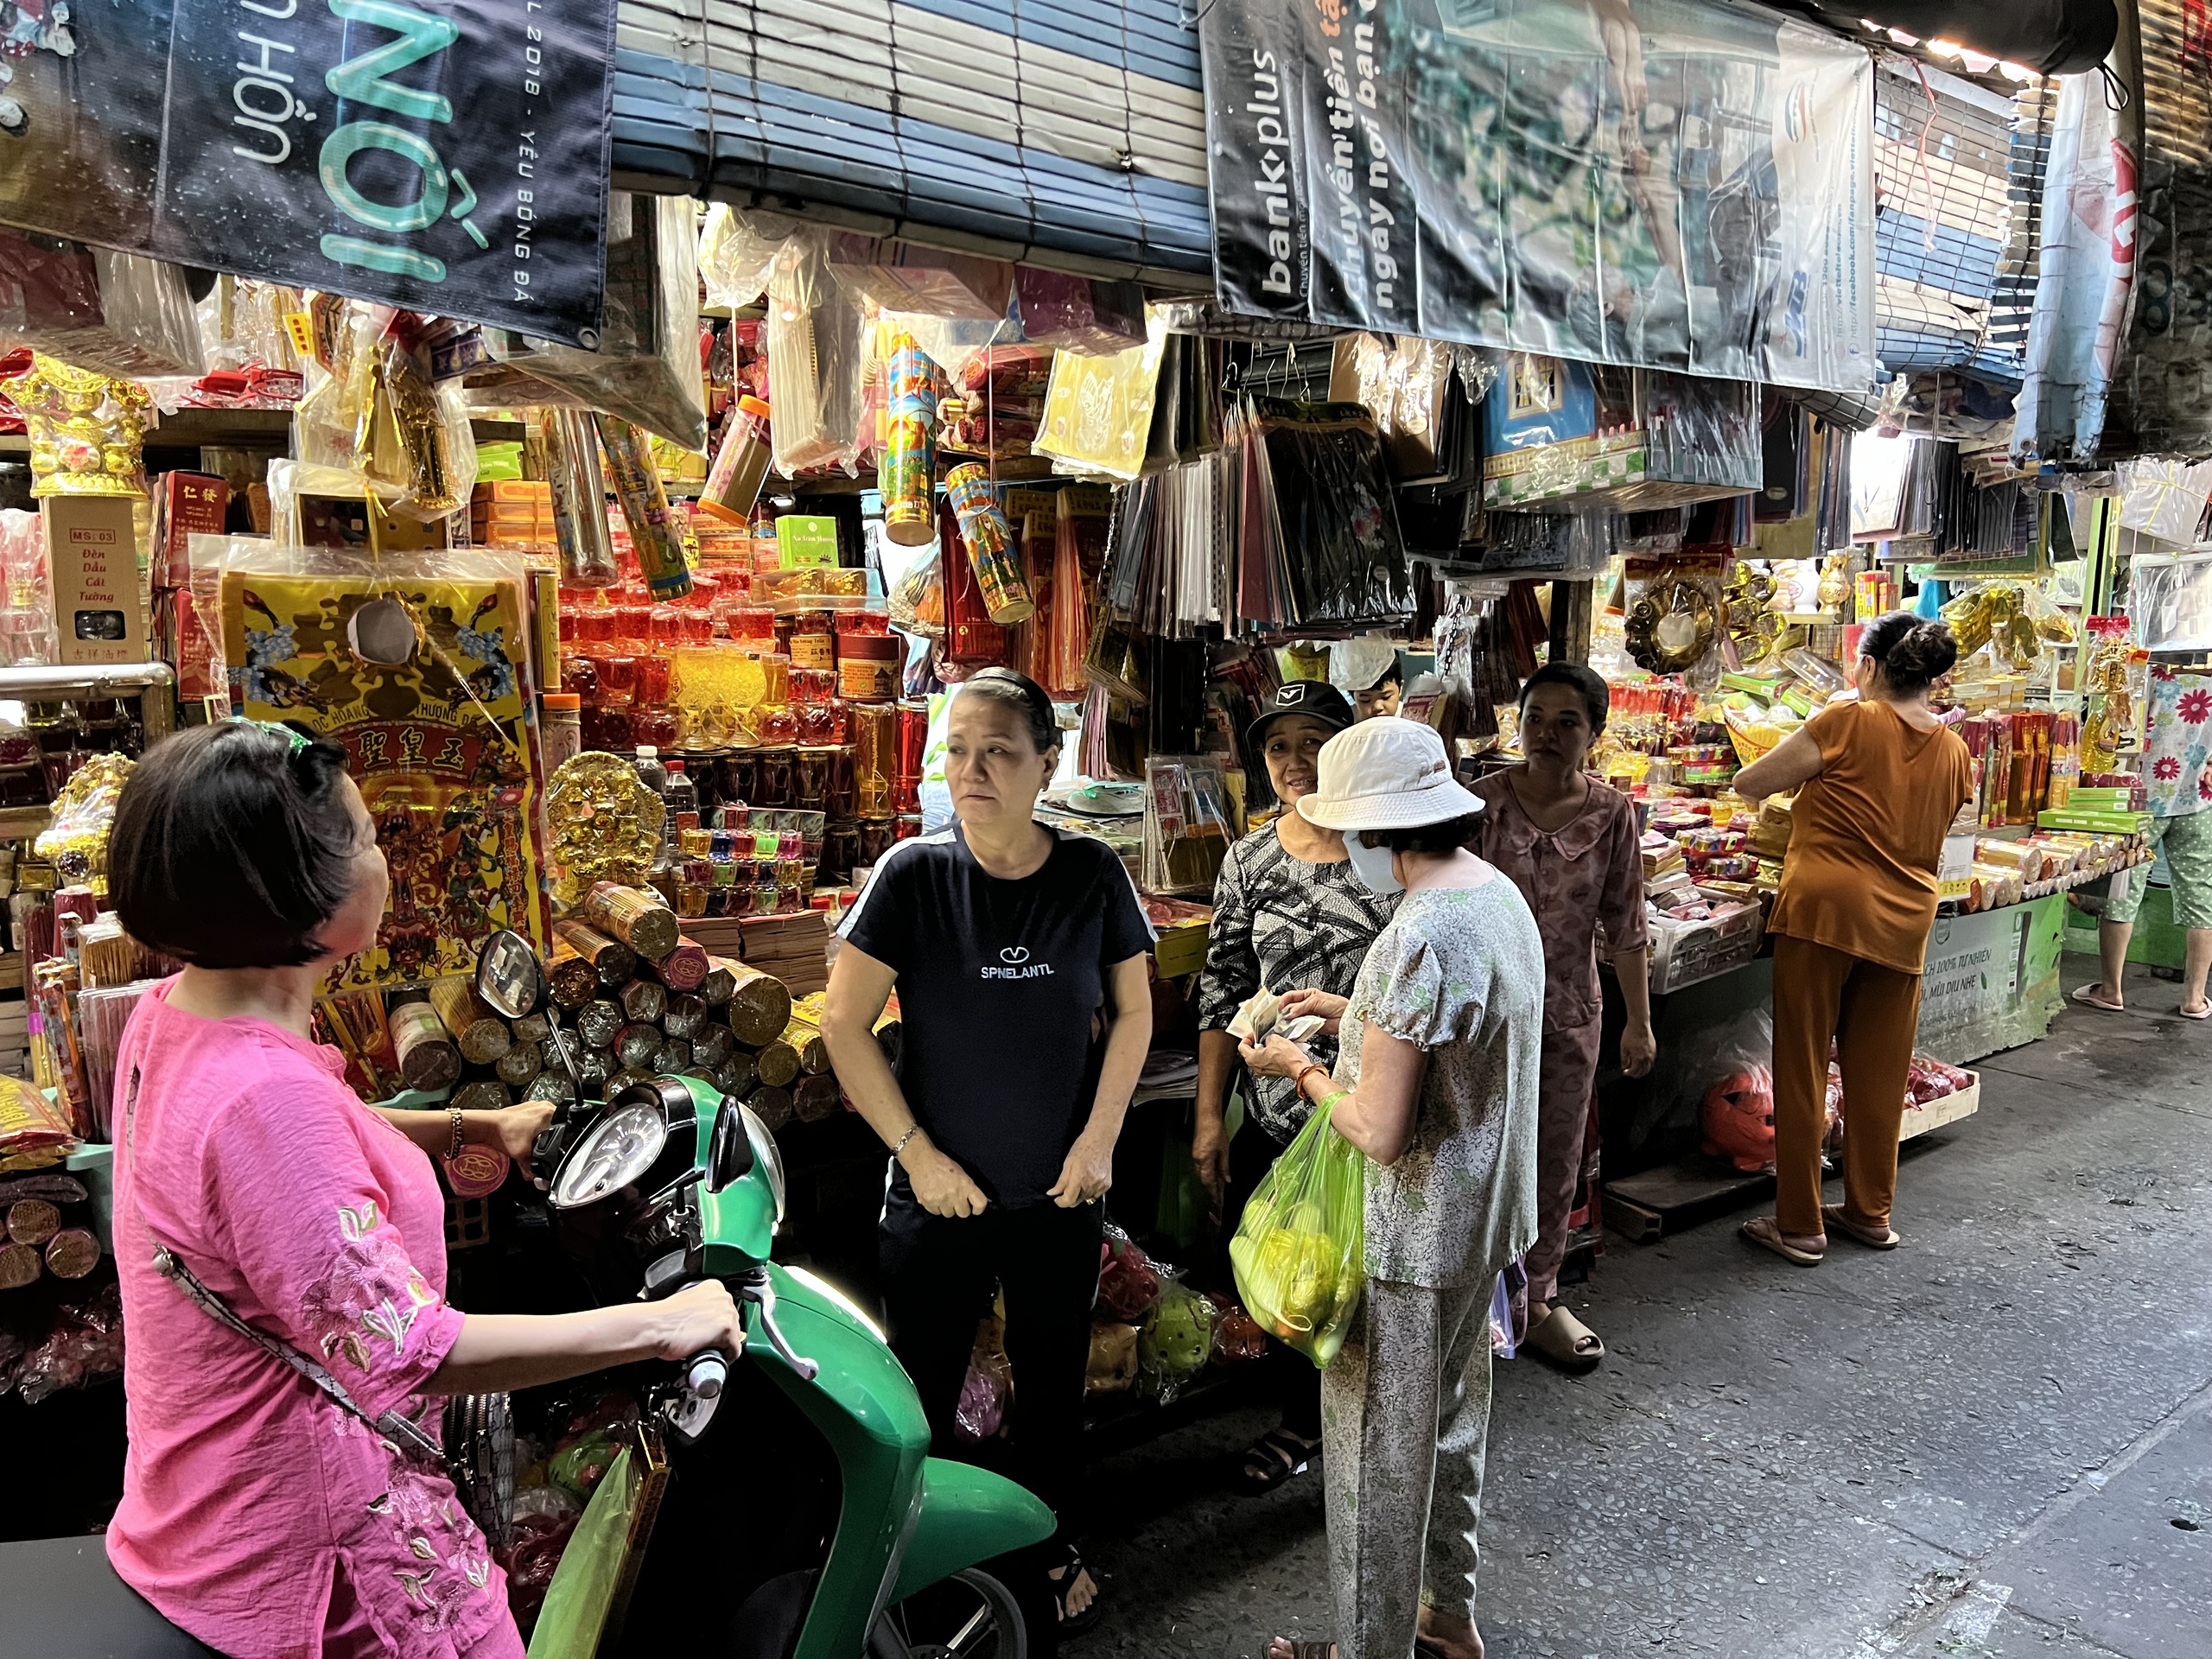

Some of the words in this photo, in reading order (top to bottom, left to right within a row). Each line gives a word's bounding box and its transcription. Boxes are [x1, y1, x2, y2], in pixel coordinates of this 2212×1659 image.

[524, 26, 542, 96] 2018
[1323, 47, 1354, 130] tiền
[1354, 22, 1381, 110] bạn
[319, 0, 489, 283] NỐI
[518, 130, 538, 178] YÊU
[1359, 115, 1389, 189] nơi
[514, 189, 537, 259] BÓNG
[1325, 139, 1366, 302] Chuyển
[1365, 198, 1398, 309] ngay
[512, 270, 535, 302] ĐÁ
[99, 532, 113, 542] 03
[981, 963, 1055, 979] SPNELANTL
